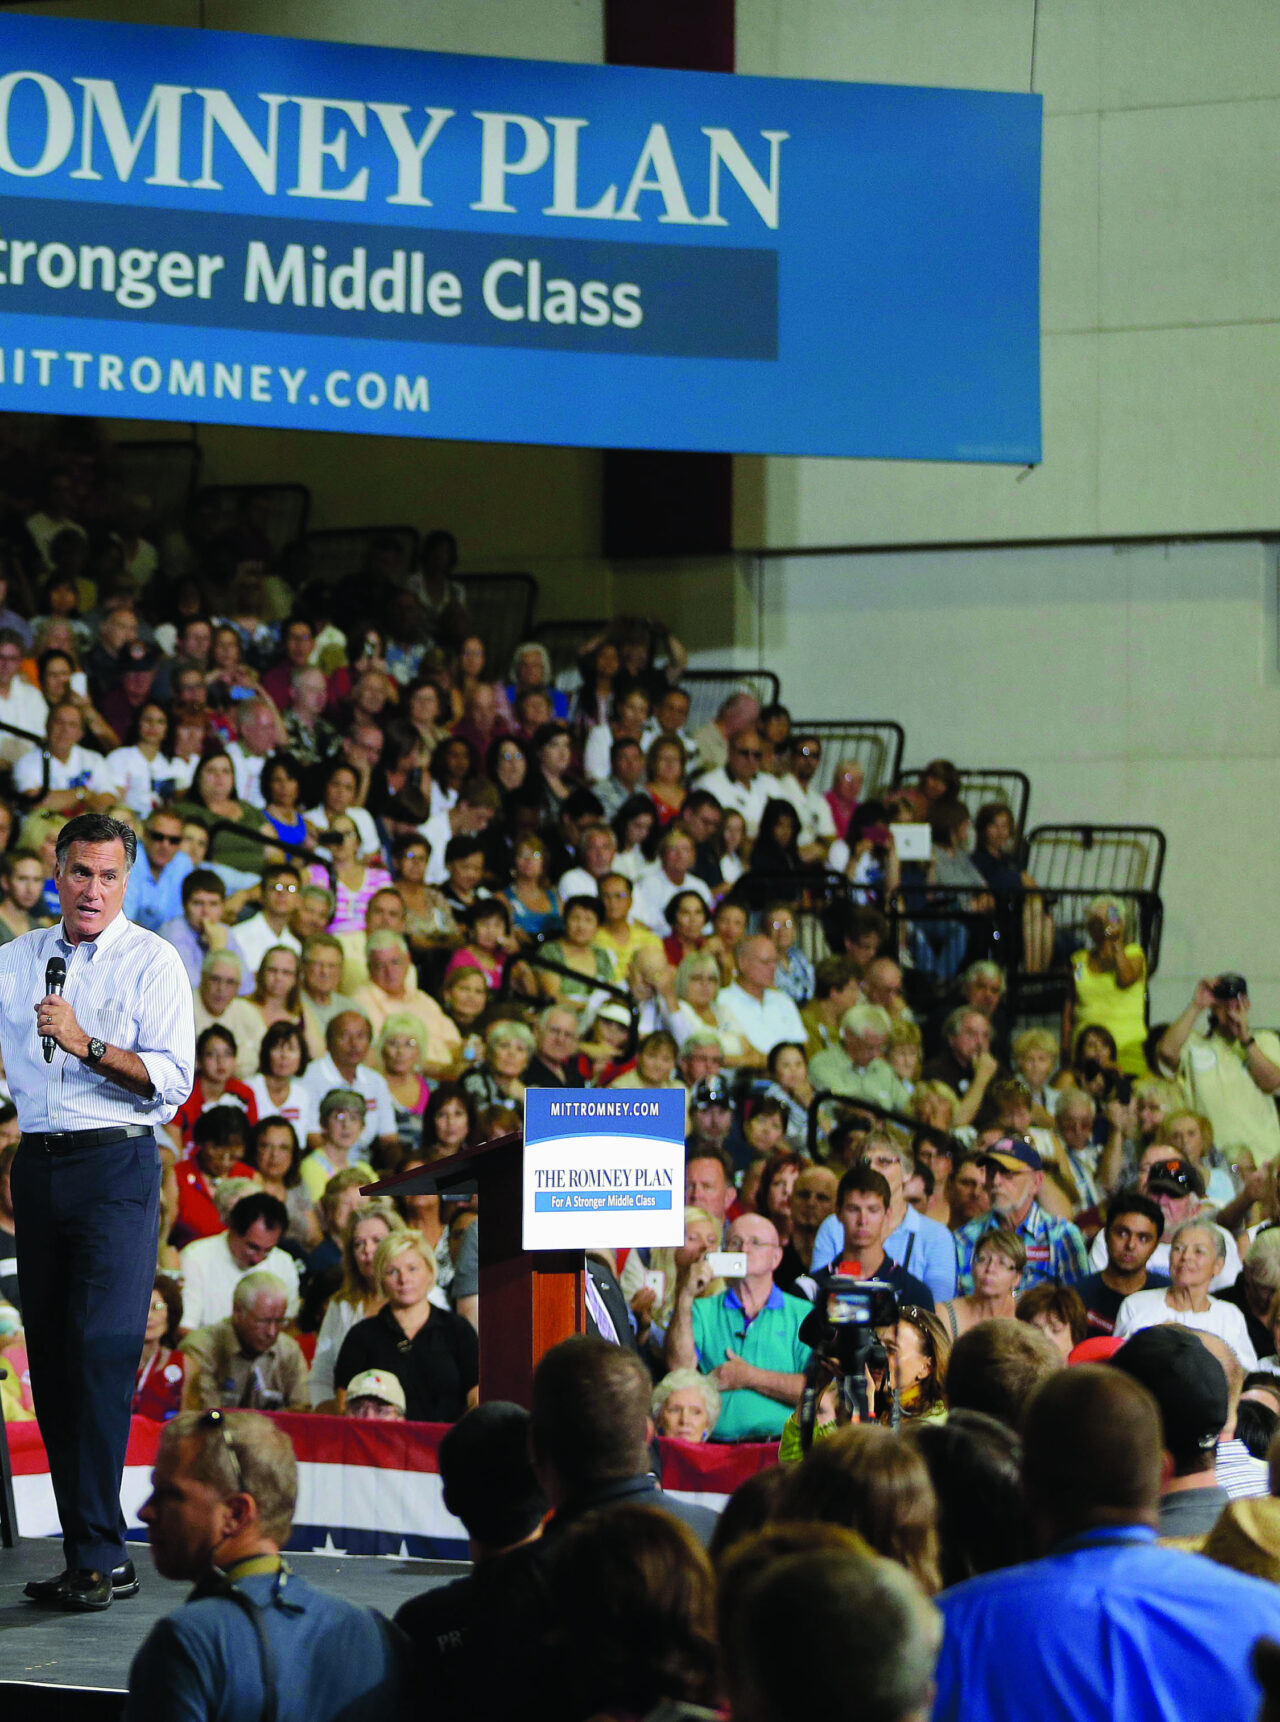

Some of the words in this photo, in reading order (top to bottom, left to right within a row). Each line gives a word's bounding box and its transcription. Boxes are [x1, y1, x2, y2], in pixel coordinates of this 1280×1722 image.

[470, 111, 790, 229] PLAN
[244, 240, 463, 317] Middle
[482, 258, 643, 329] Class
[550, 1102, 660, 1116] MITTROMNEY.COM
[534, 1169, 566, 1188] THE
[569, 1168, 632, 1188] ROMNEY
[635, 1168, 673, 1187] PLAN
[551, 1195, 565, 1207] For
[565, 1195, 572, 1207] A
[573, 1195, 606, 1209] Stronger
[607, 1194, 634, 1207] Middle
[635, 1194, 656, 1206] Class
